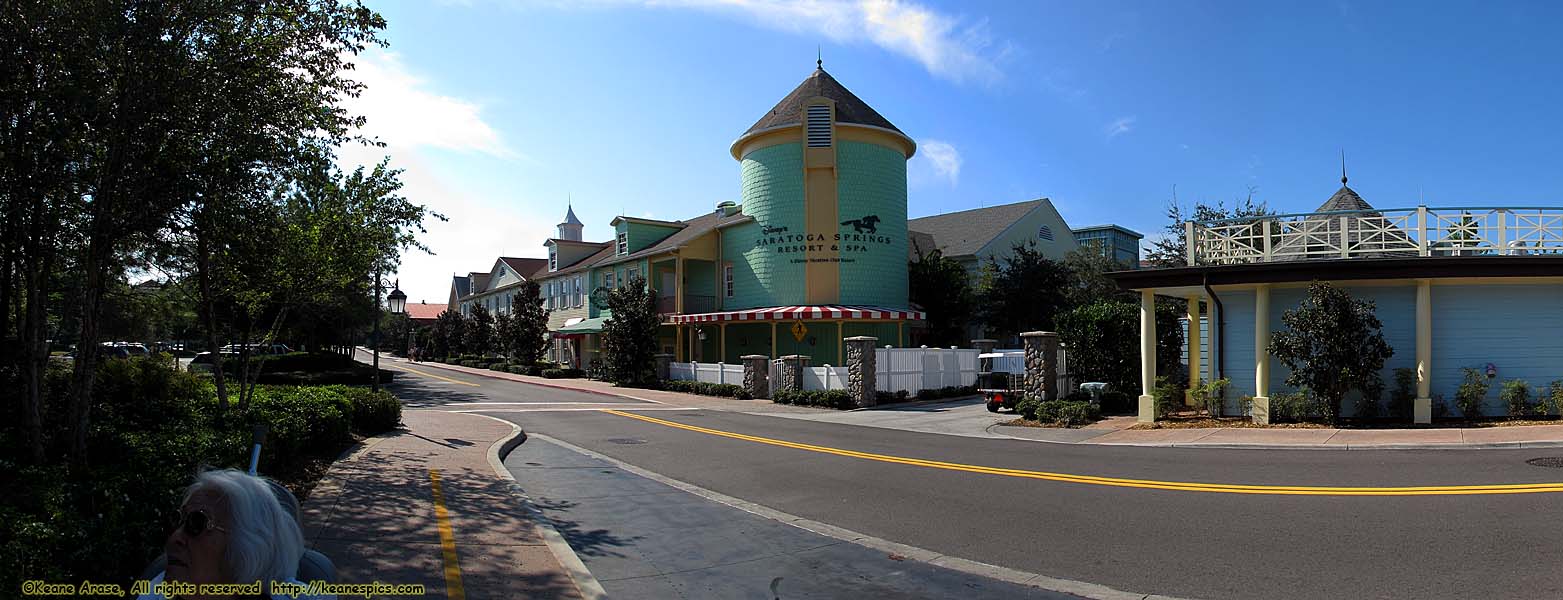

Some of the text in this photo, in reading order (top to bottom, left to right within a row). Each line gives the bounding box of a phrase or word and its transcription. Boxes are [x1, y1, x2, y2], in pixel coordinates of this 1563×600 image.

[756, 233, 892, 246] SARATOGA SPRINGS
[777, 244, 867, 253] RESORT & SPA
